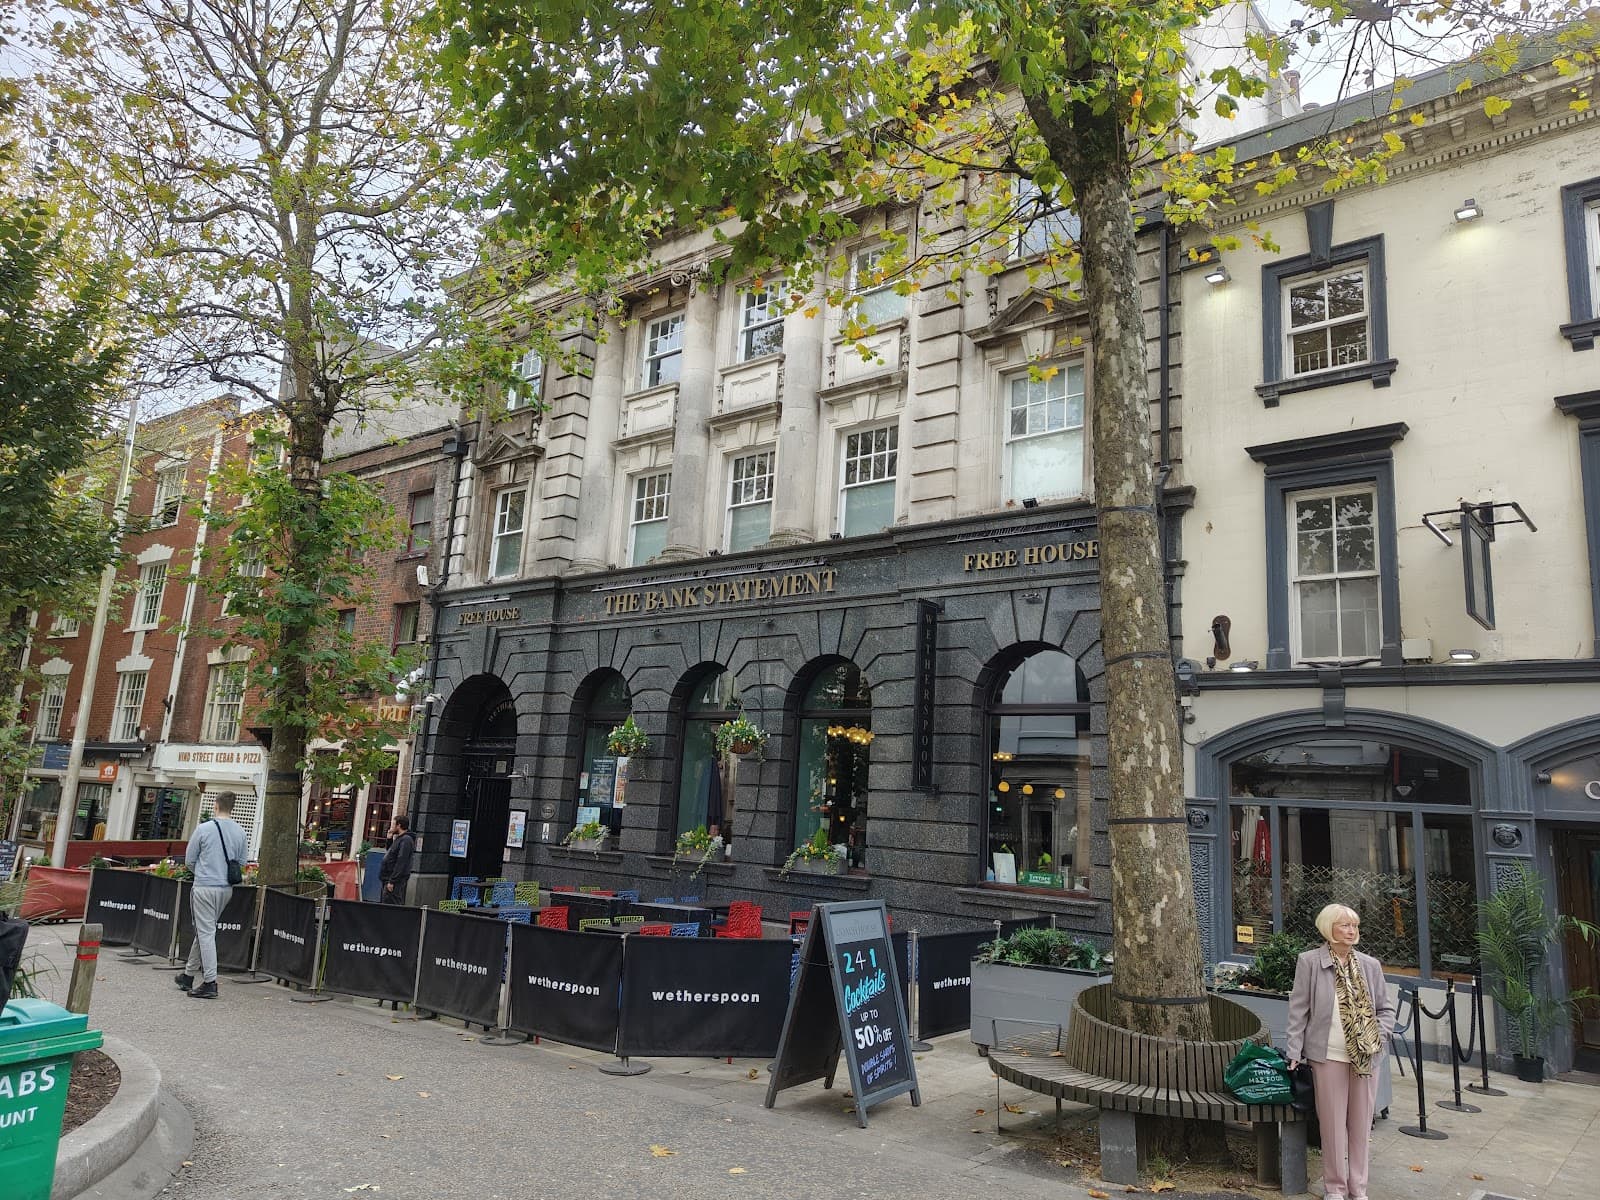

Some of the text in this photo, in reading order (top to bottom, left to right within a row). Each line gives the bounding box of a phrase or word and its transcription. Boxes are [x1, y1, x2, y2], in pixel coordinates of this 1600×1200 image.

[964, 540, 1099, 571] FREE HOUSE
[604, 569, 838, 615] THE BANK STATEMENT
[458, 607, 520, 625] FREE HOUSE
[378, 697, 409, 722] bar
[192, 752, 214, 763] STREET
[215, 752, 234, 763] KEBAB
[242, 753, 261, 764] PIZZA
[100, 900, 136, 911] wetherspoon
[343, 942, 402, 958] wetherspoon
[435, 957, 488, 976] wetherspoon
[528, 974, 600, 996] wetherspoon
[845, 968, 886, 1016] Cocktails
[652, 989, 760, 1004] wetherspoon
[861, 1009, 878, 1022] UP TO
[855, 1024, 892, 1050] 50% OFF
[867, 1072, 874, 1085] OF
